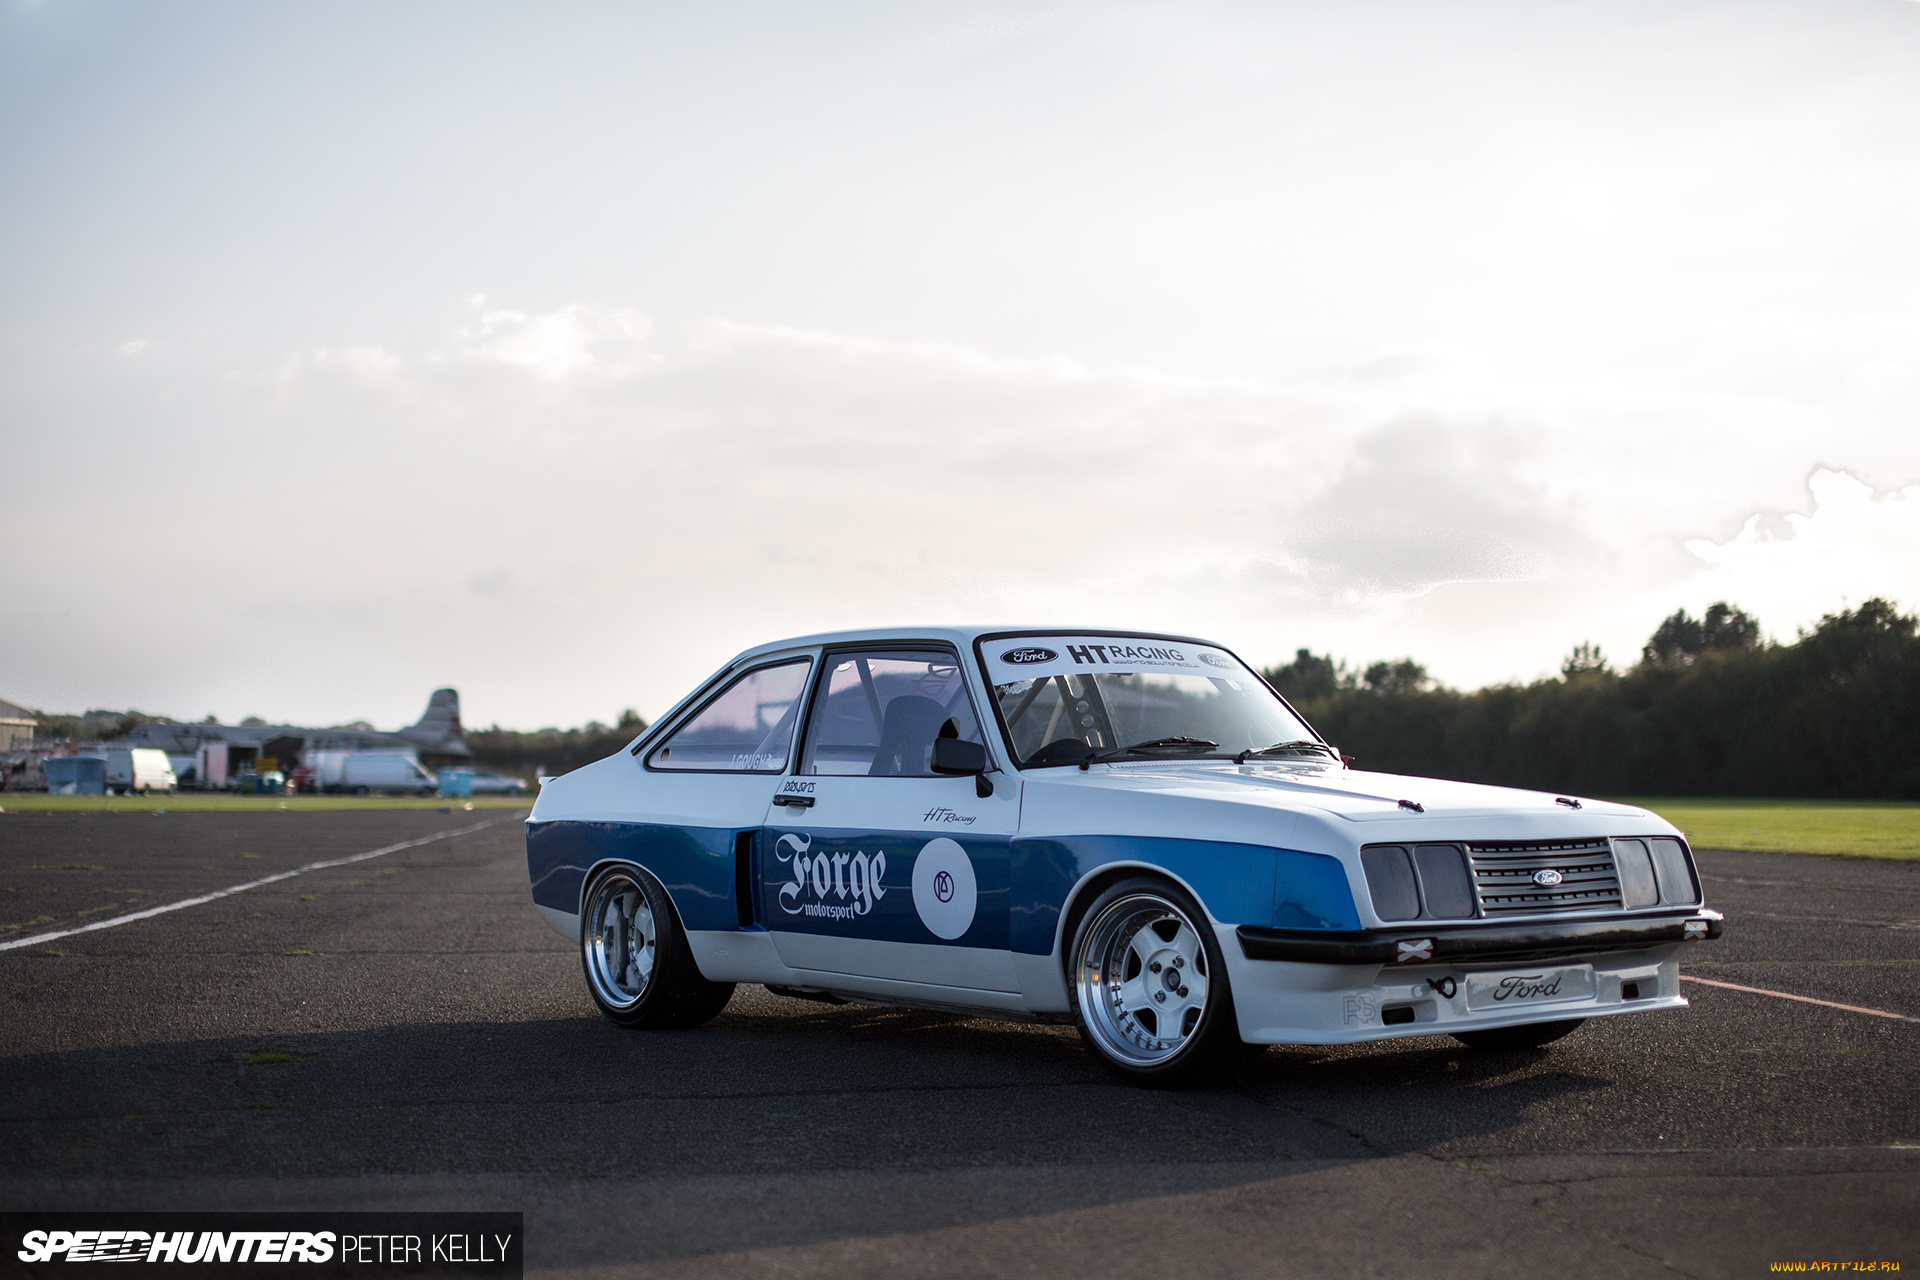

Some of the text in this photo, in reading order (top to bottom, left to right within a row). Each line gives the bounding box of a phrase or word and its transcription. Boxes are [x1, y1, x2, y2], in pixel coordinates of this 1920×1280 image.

[1013, 649, 1048, 663] Ford
[1065, 645, 1185, 665] HT RACING
[1206, 655, 1233, 669] Ford
[775, 832, 887, 915] Forge
[1541, 872, 1558, 883] Ford
[804, 901, 855, 921] motorsport
[1493, 975, 1562, 1002] Ford
